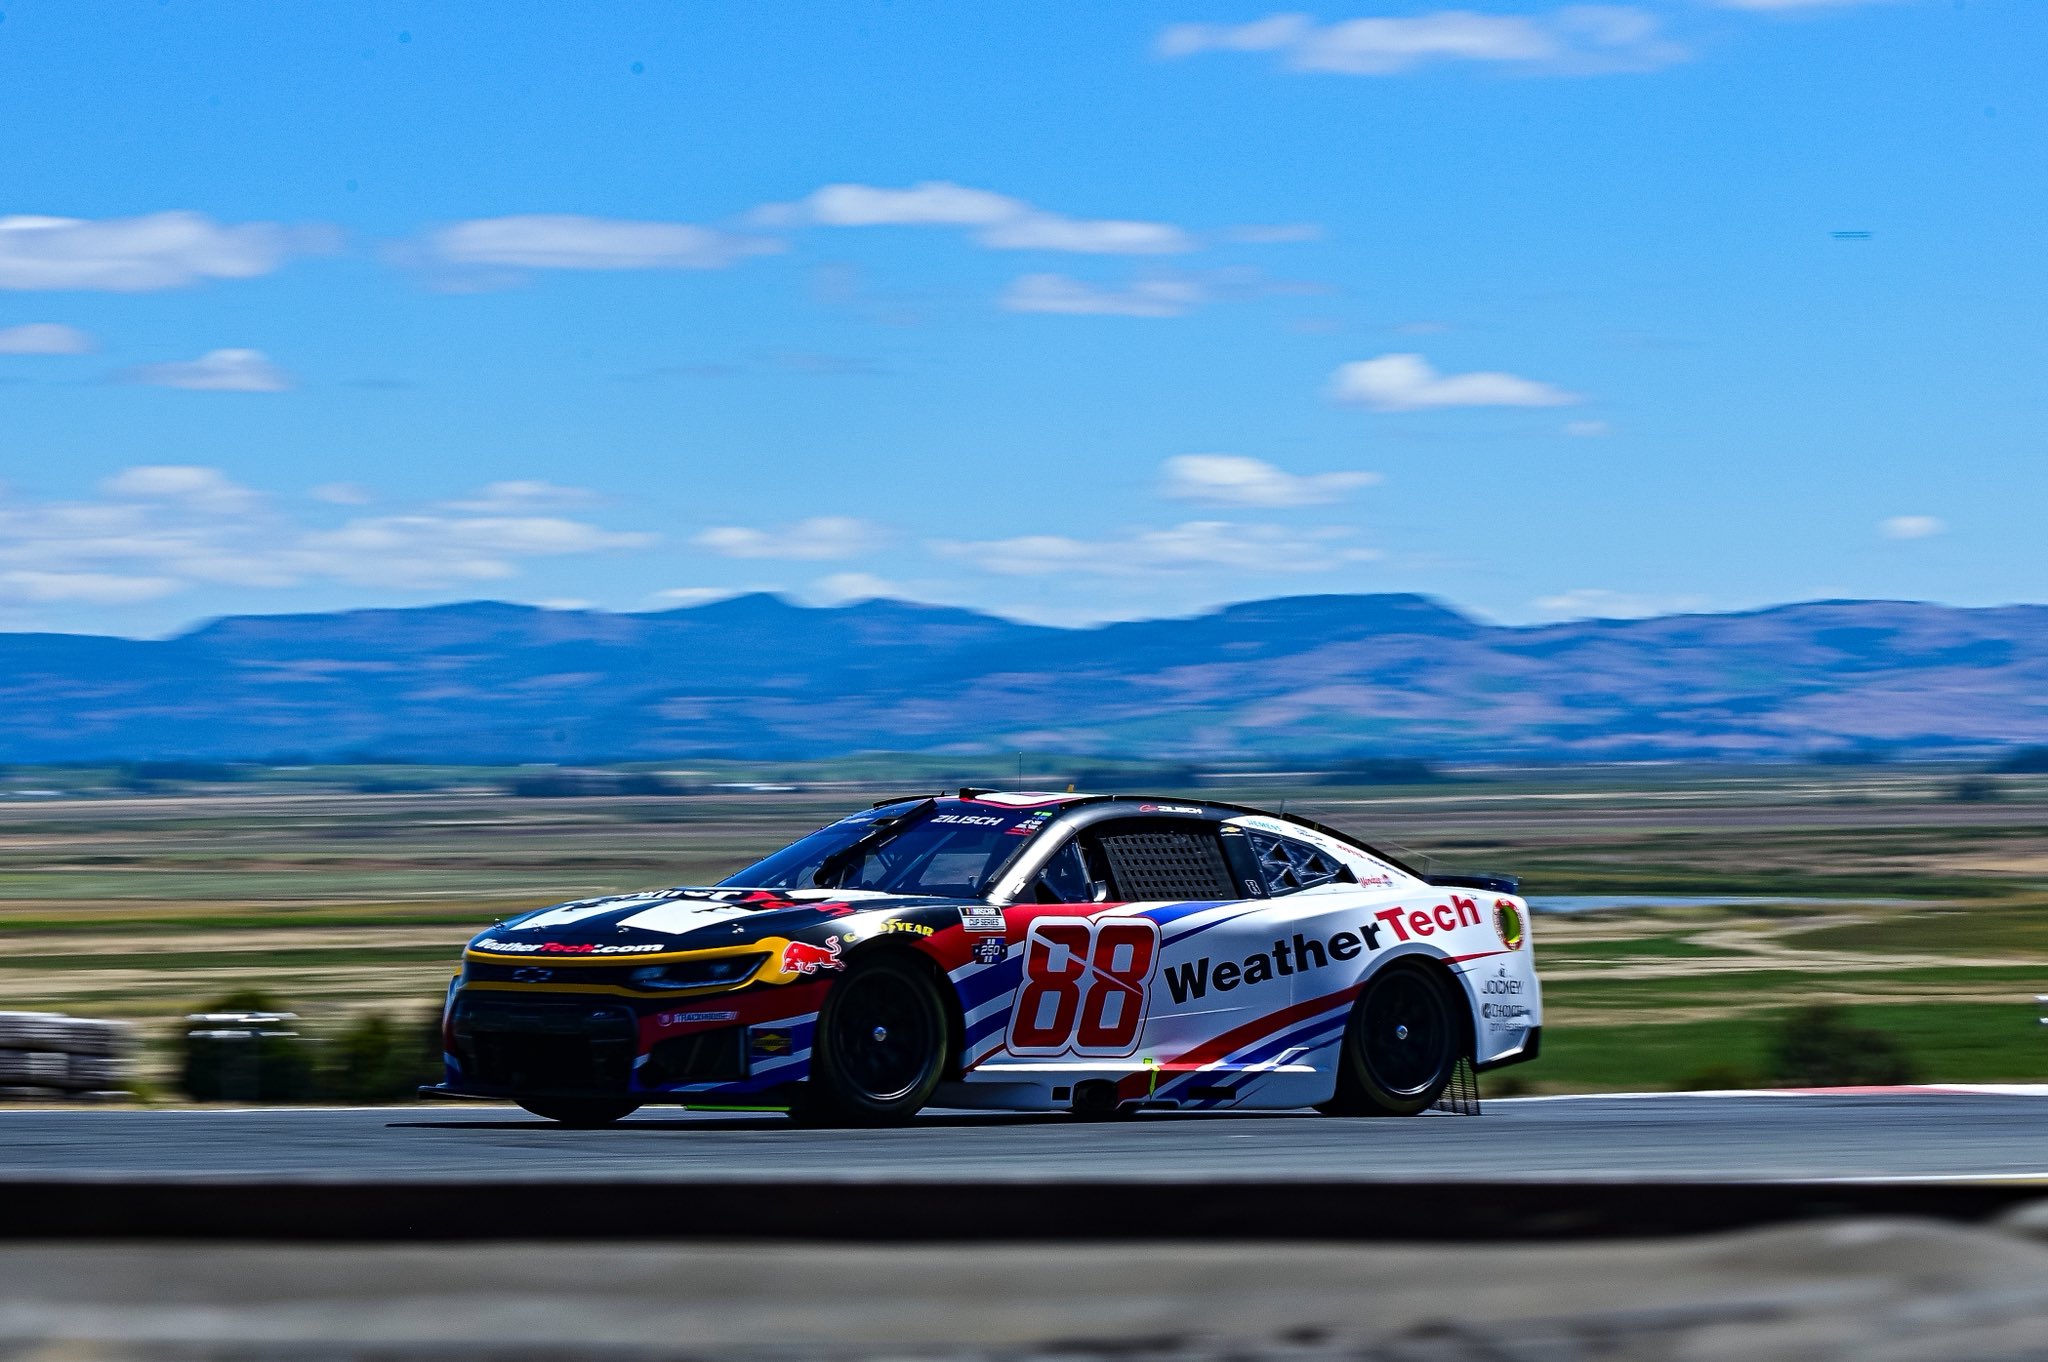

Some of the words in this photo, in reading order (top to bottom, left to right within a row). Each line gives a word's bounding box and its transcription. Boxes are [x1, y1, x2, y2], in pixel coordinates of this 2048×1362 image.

[930, 814, 1004, 826] ZILISCH
[981, 918, 1000, 926] SERIES
[980, 945, 1000, 956] 250
[1164, 894, 1481, 1004] WeatherTech
[1007, 919, 1158, 1054] 88
[1482, 980, 1524, 995] JOCKEY
